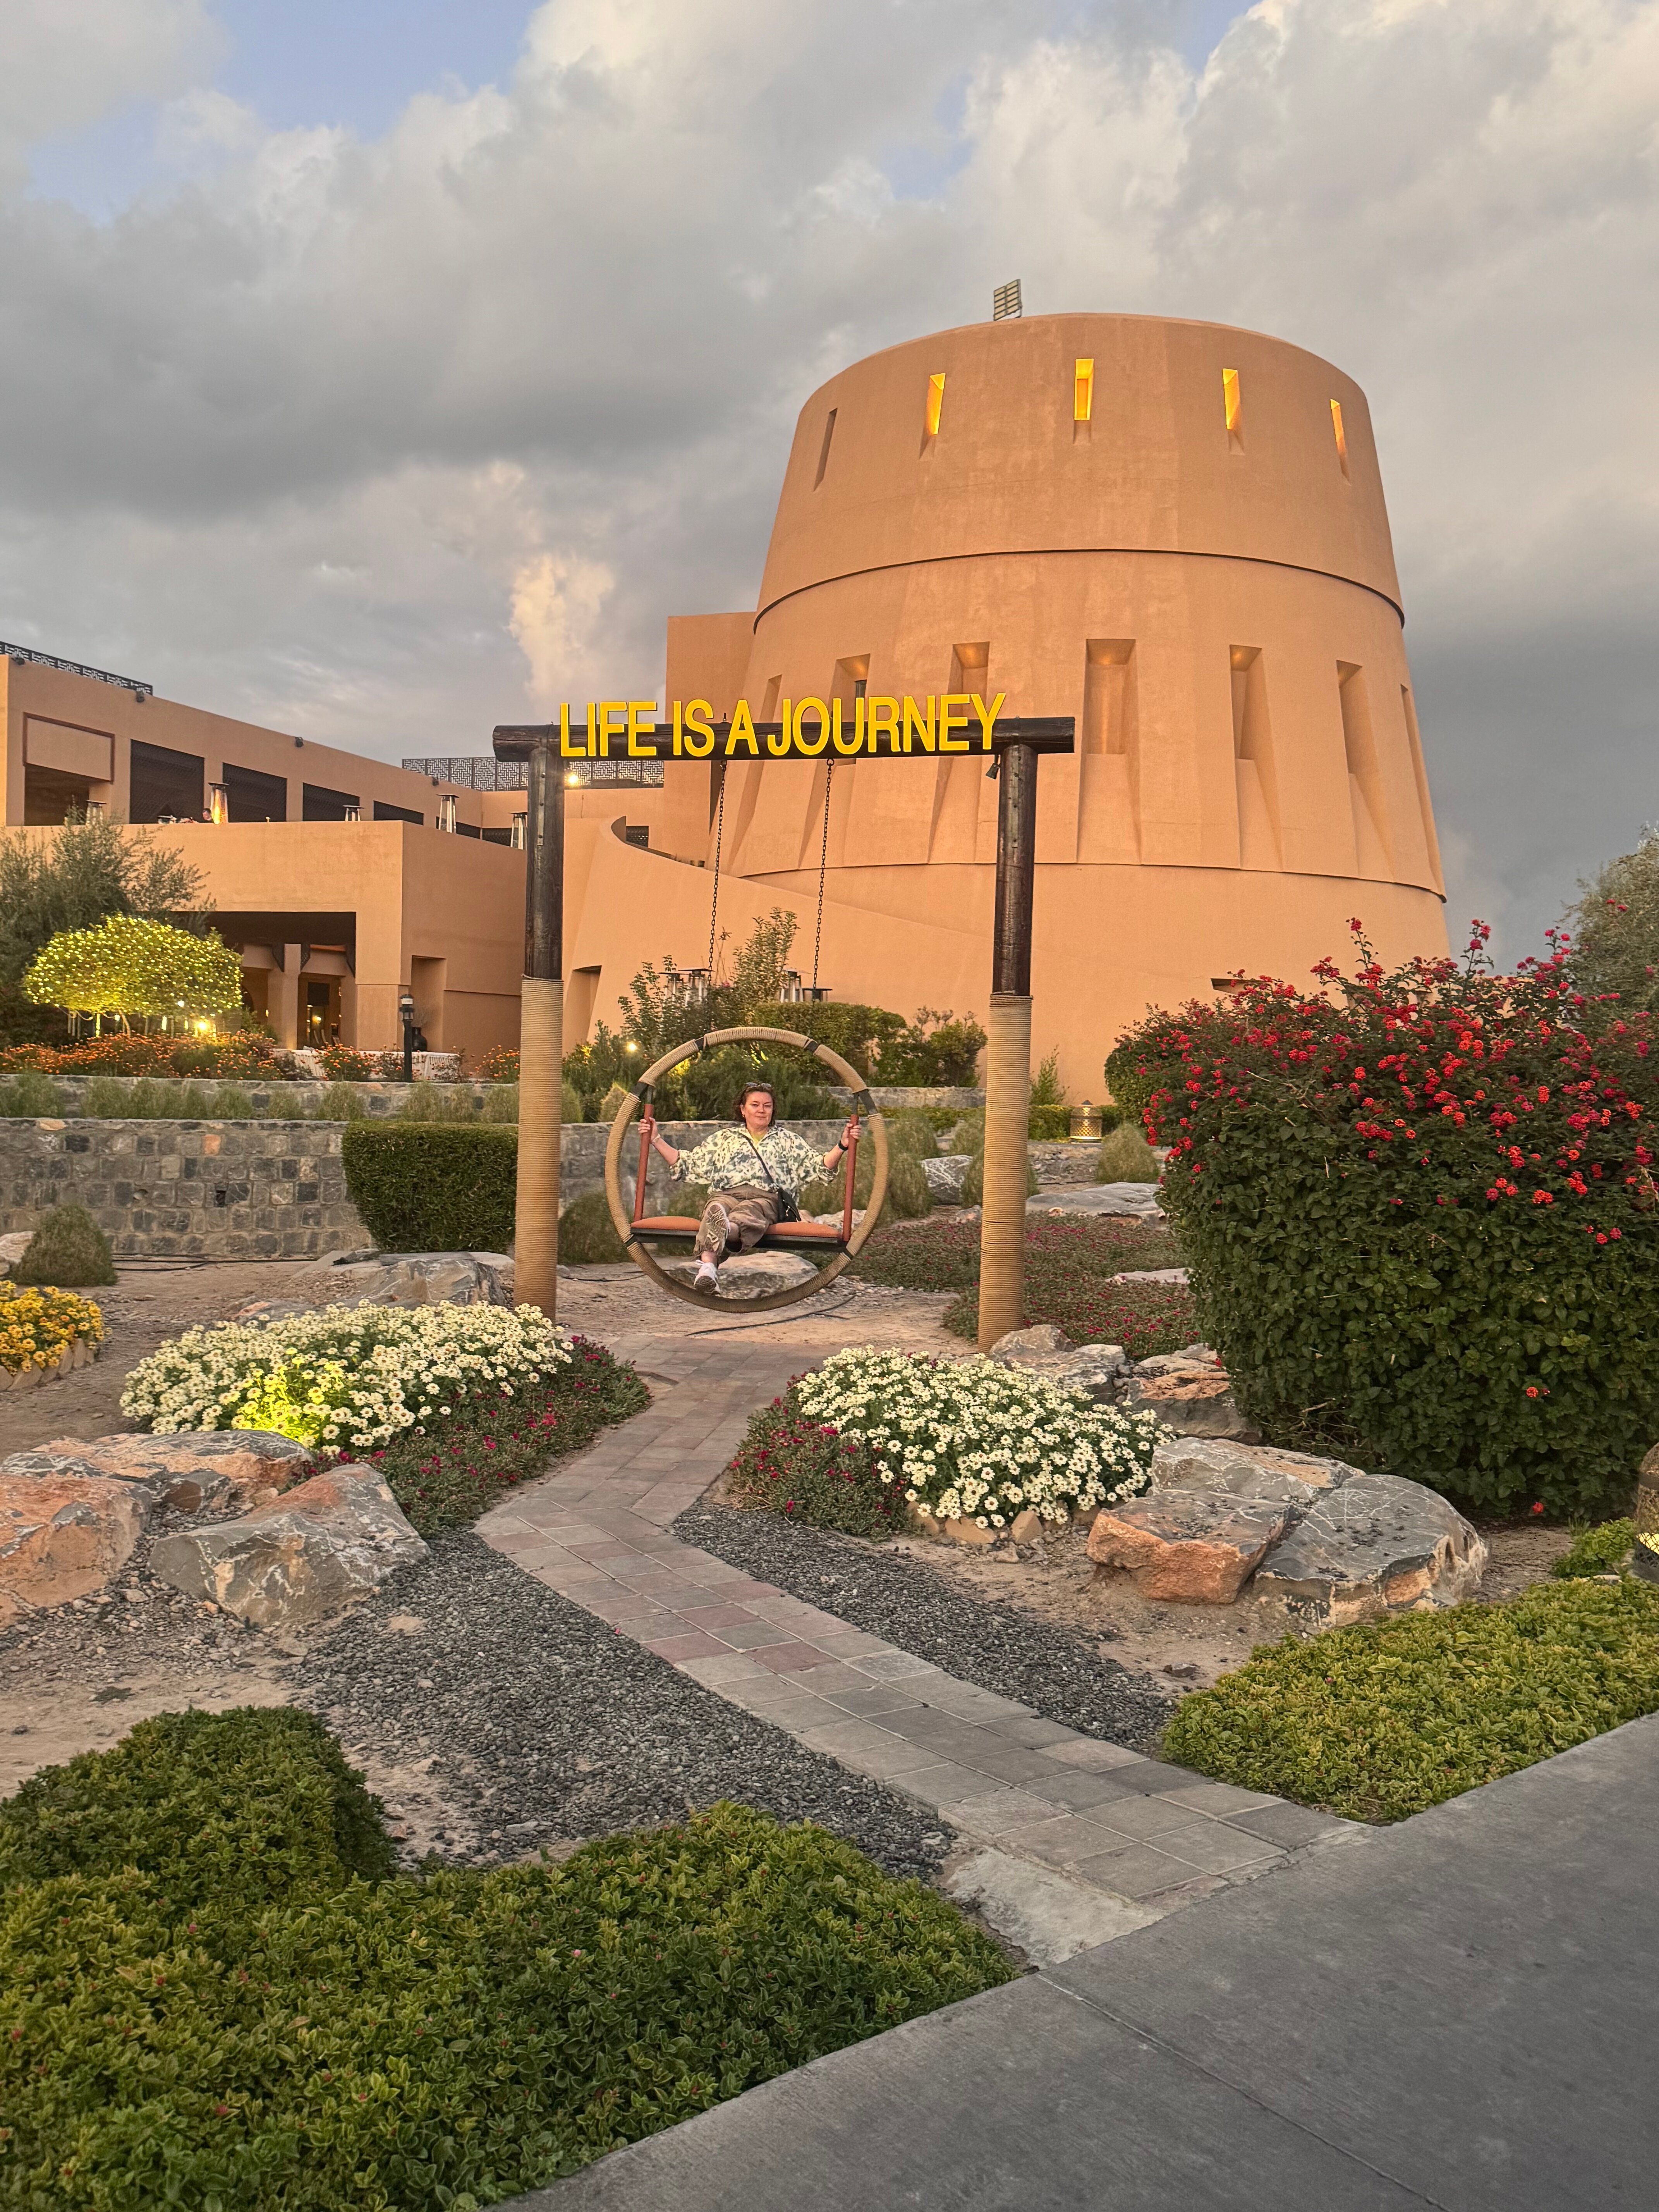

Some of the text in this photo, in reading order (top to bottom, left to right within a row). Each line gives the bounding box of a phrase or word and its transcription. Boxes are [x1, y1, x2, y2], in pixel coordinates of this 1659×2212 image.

[560, 693, 1006, 757] LIFE IS A JOURNEY
